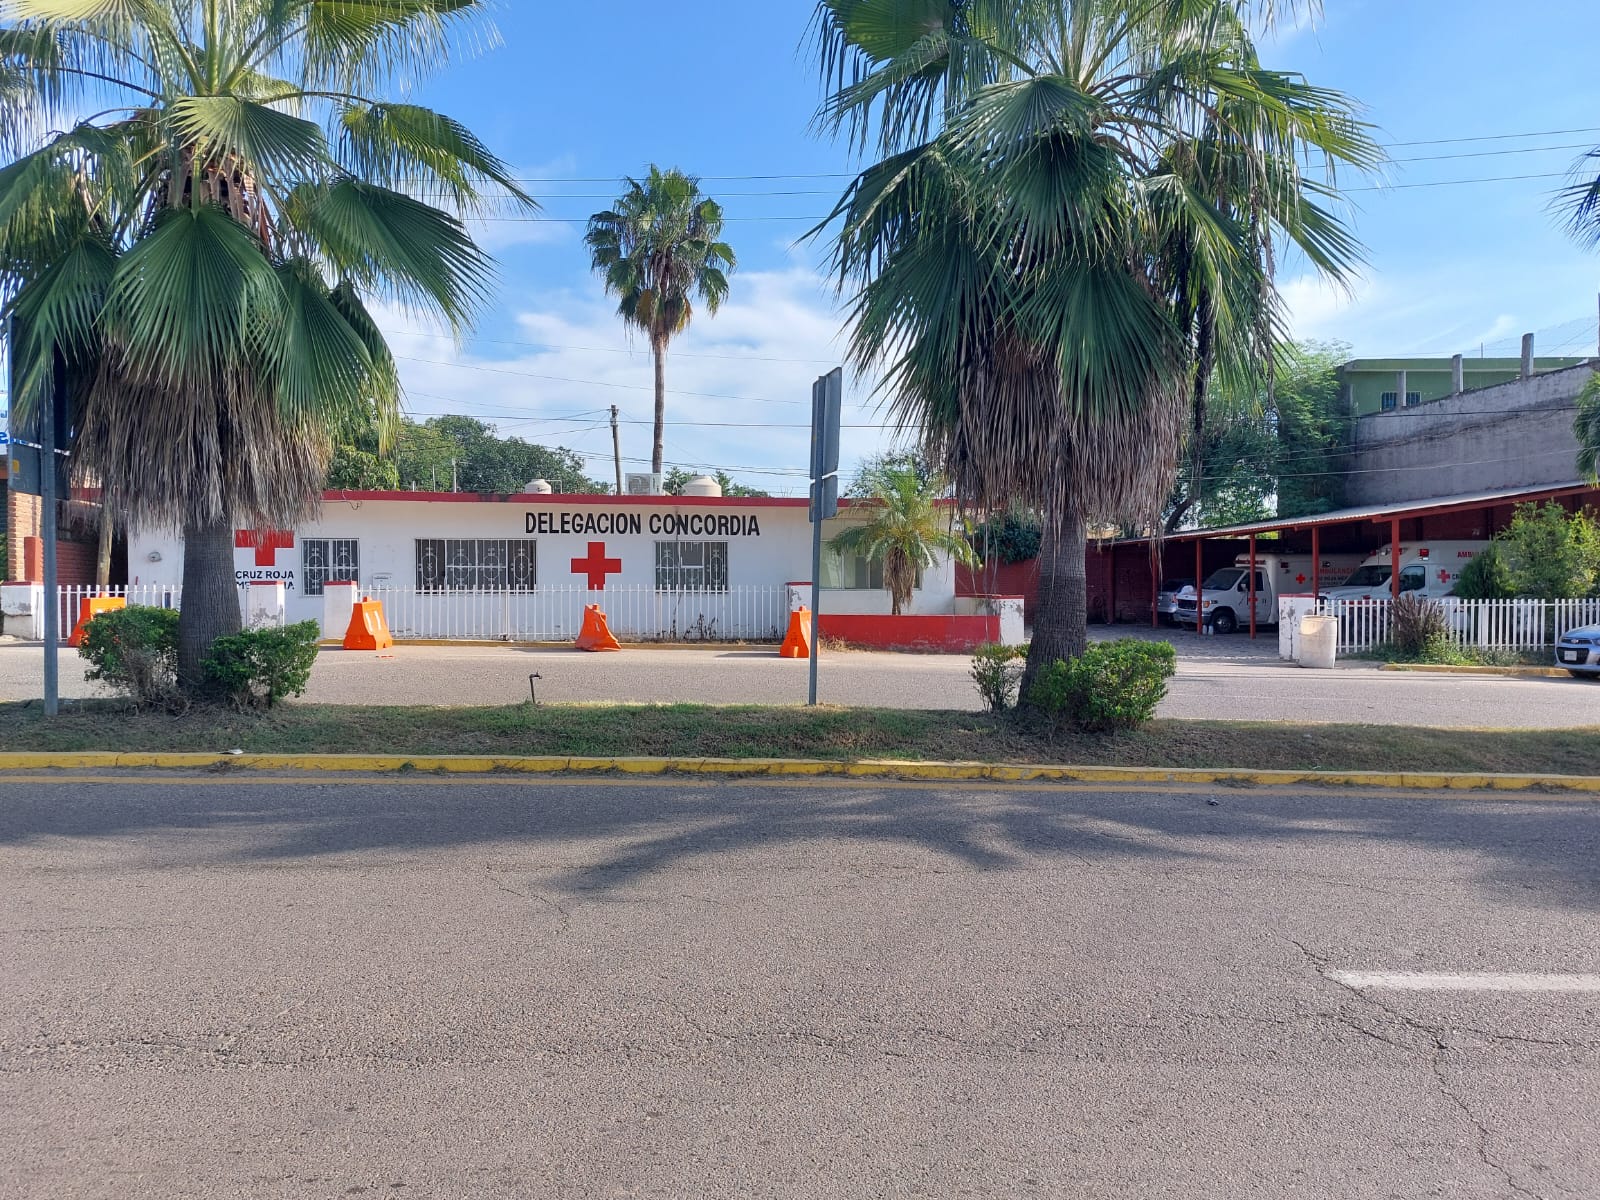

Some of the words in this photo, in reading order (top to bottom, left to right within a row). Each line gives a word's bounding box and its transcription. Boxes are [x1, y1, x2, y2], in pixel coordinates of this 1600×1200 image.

[525, 512, 641, 534] DELEGACION
[649, 513, 761, 536] CONCORDIA
[235, 570, 263, 579] CRUZ
[265, 570, 294, 579] ROJA
